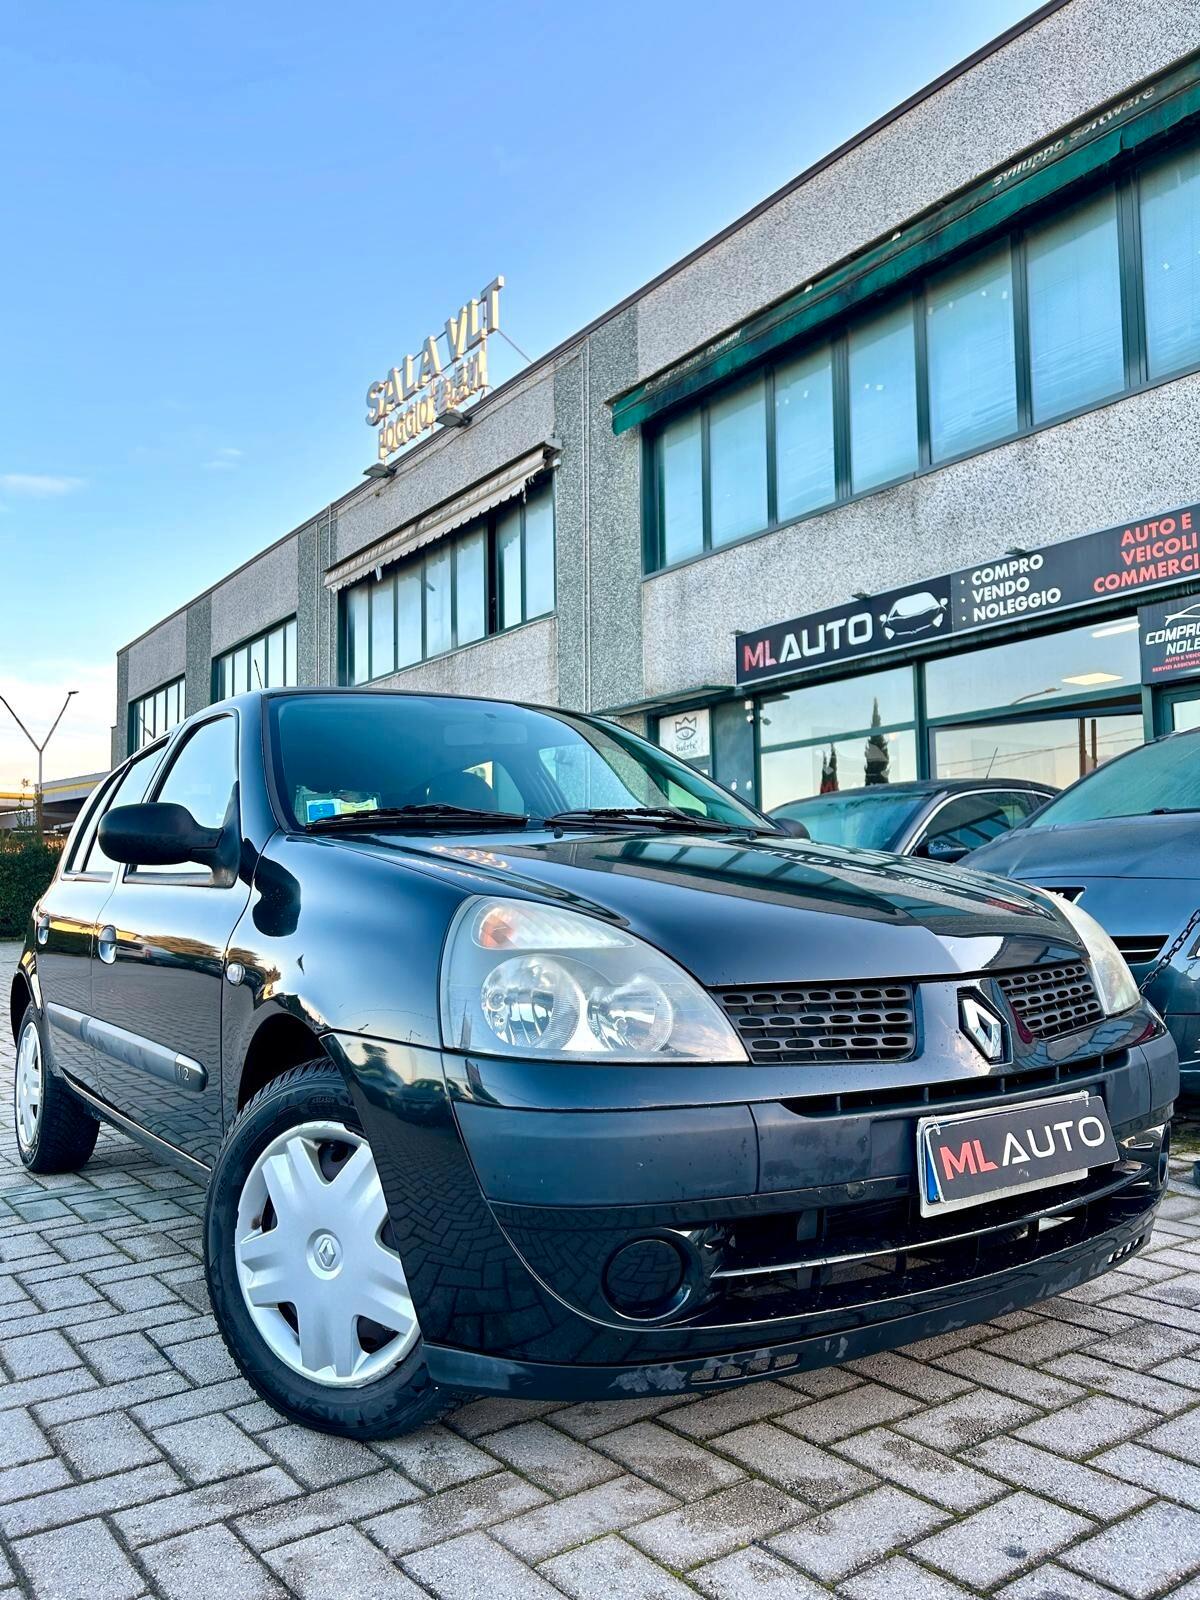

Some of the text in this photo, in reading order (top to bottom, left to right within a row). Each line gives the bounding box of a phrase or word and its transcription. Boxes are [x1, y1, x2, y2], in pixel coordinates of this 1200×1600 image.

[366, 335, 442, 427] SALA
[445, 275, 505, 363] VLT
[1121, 512, 1192, 547] AUTO E
[1121, 532, 1198, 566] VEICOLI
[971, 554, 1044, 586] COMPRO
[972, 576, 1030, 604] VENDO
[973, 587, 1062, 622] NOLEGGIO
